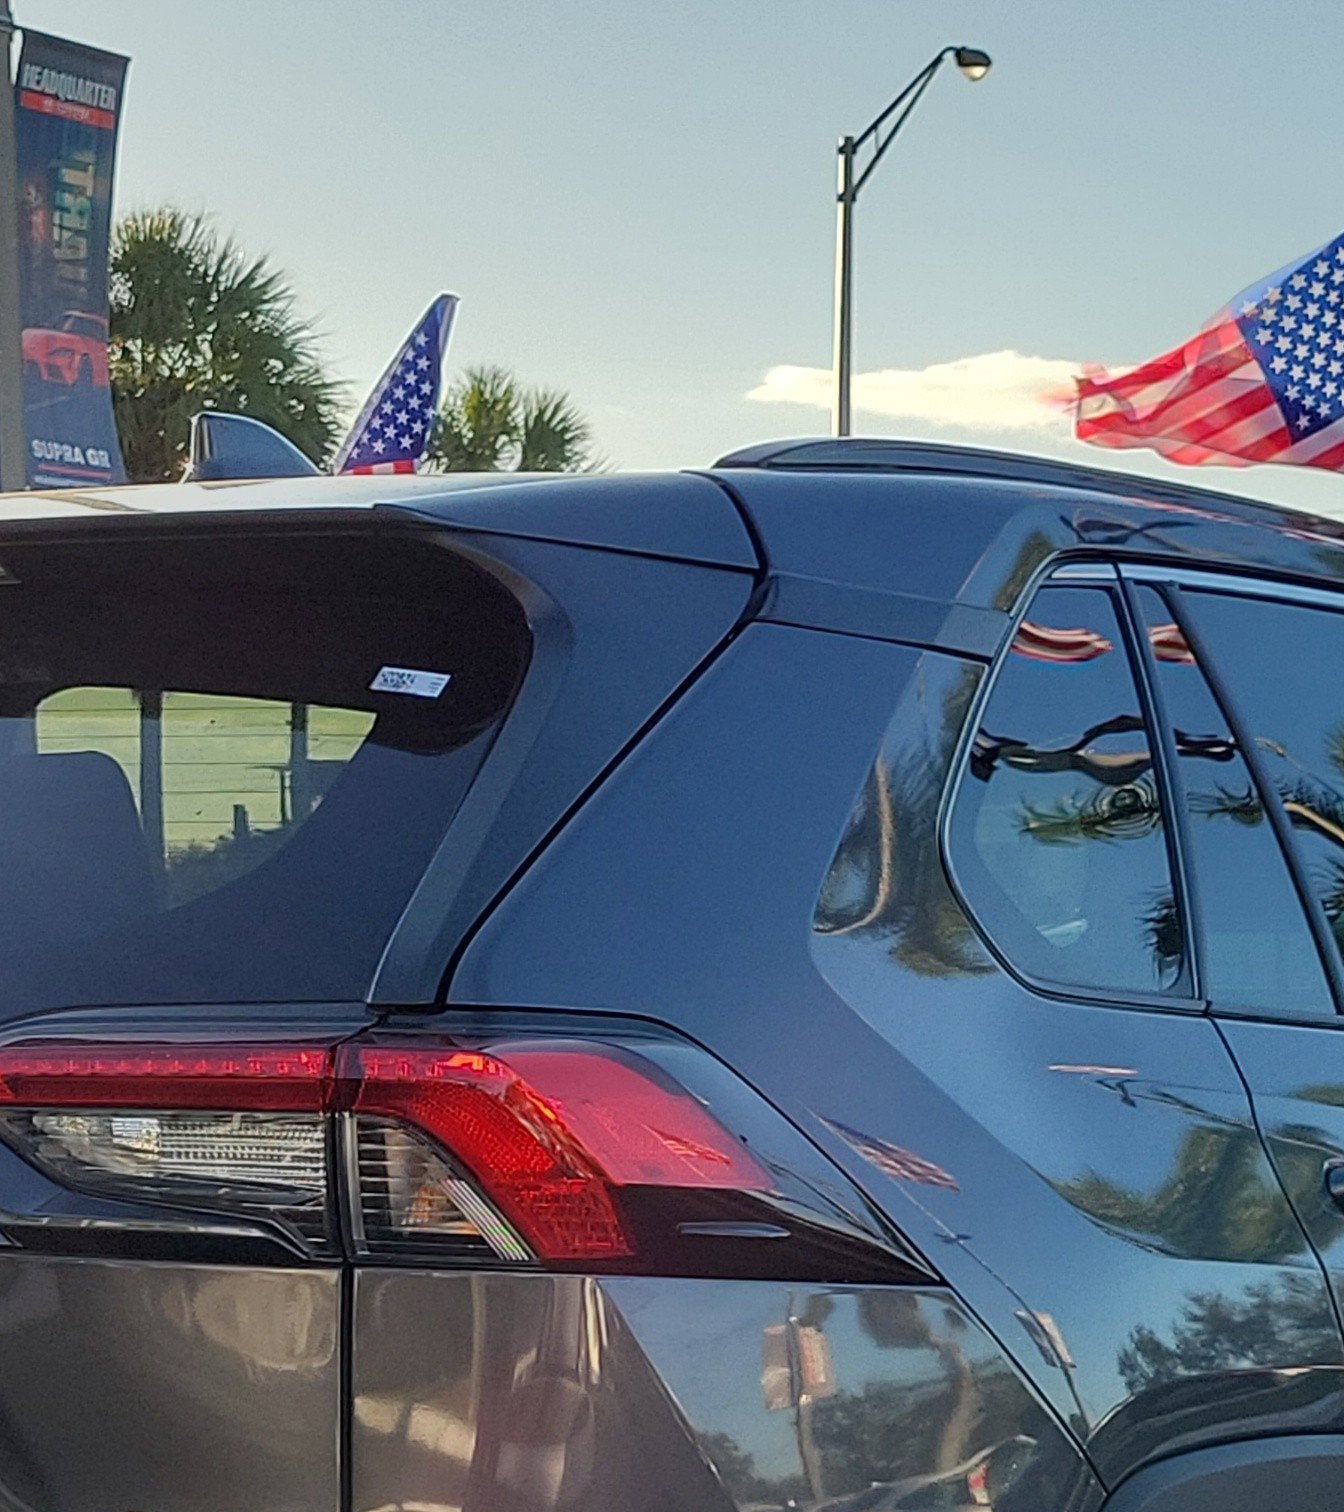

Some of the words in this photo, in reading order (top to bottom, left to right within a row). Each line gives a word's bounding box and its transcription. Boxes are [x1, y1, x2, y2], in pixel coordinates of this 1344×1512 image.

[21, 63, 116, 111] HEADQUARTER
[31, 439, 86, 465] SUPRA
[85, 447, 111, 468] GR
